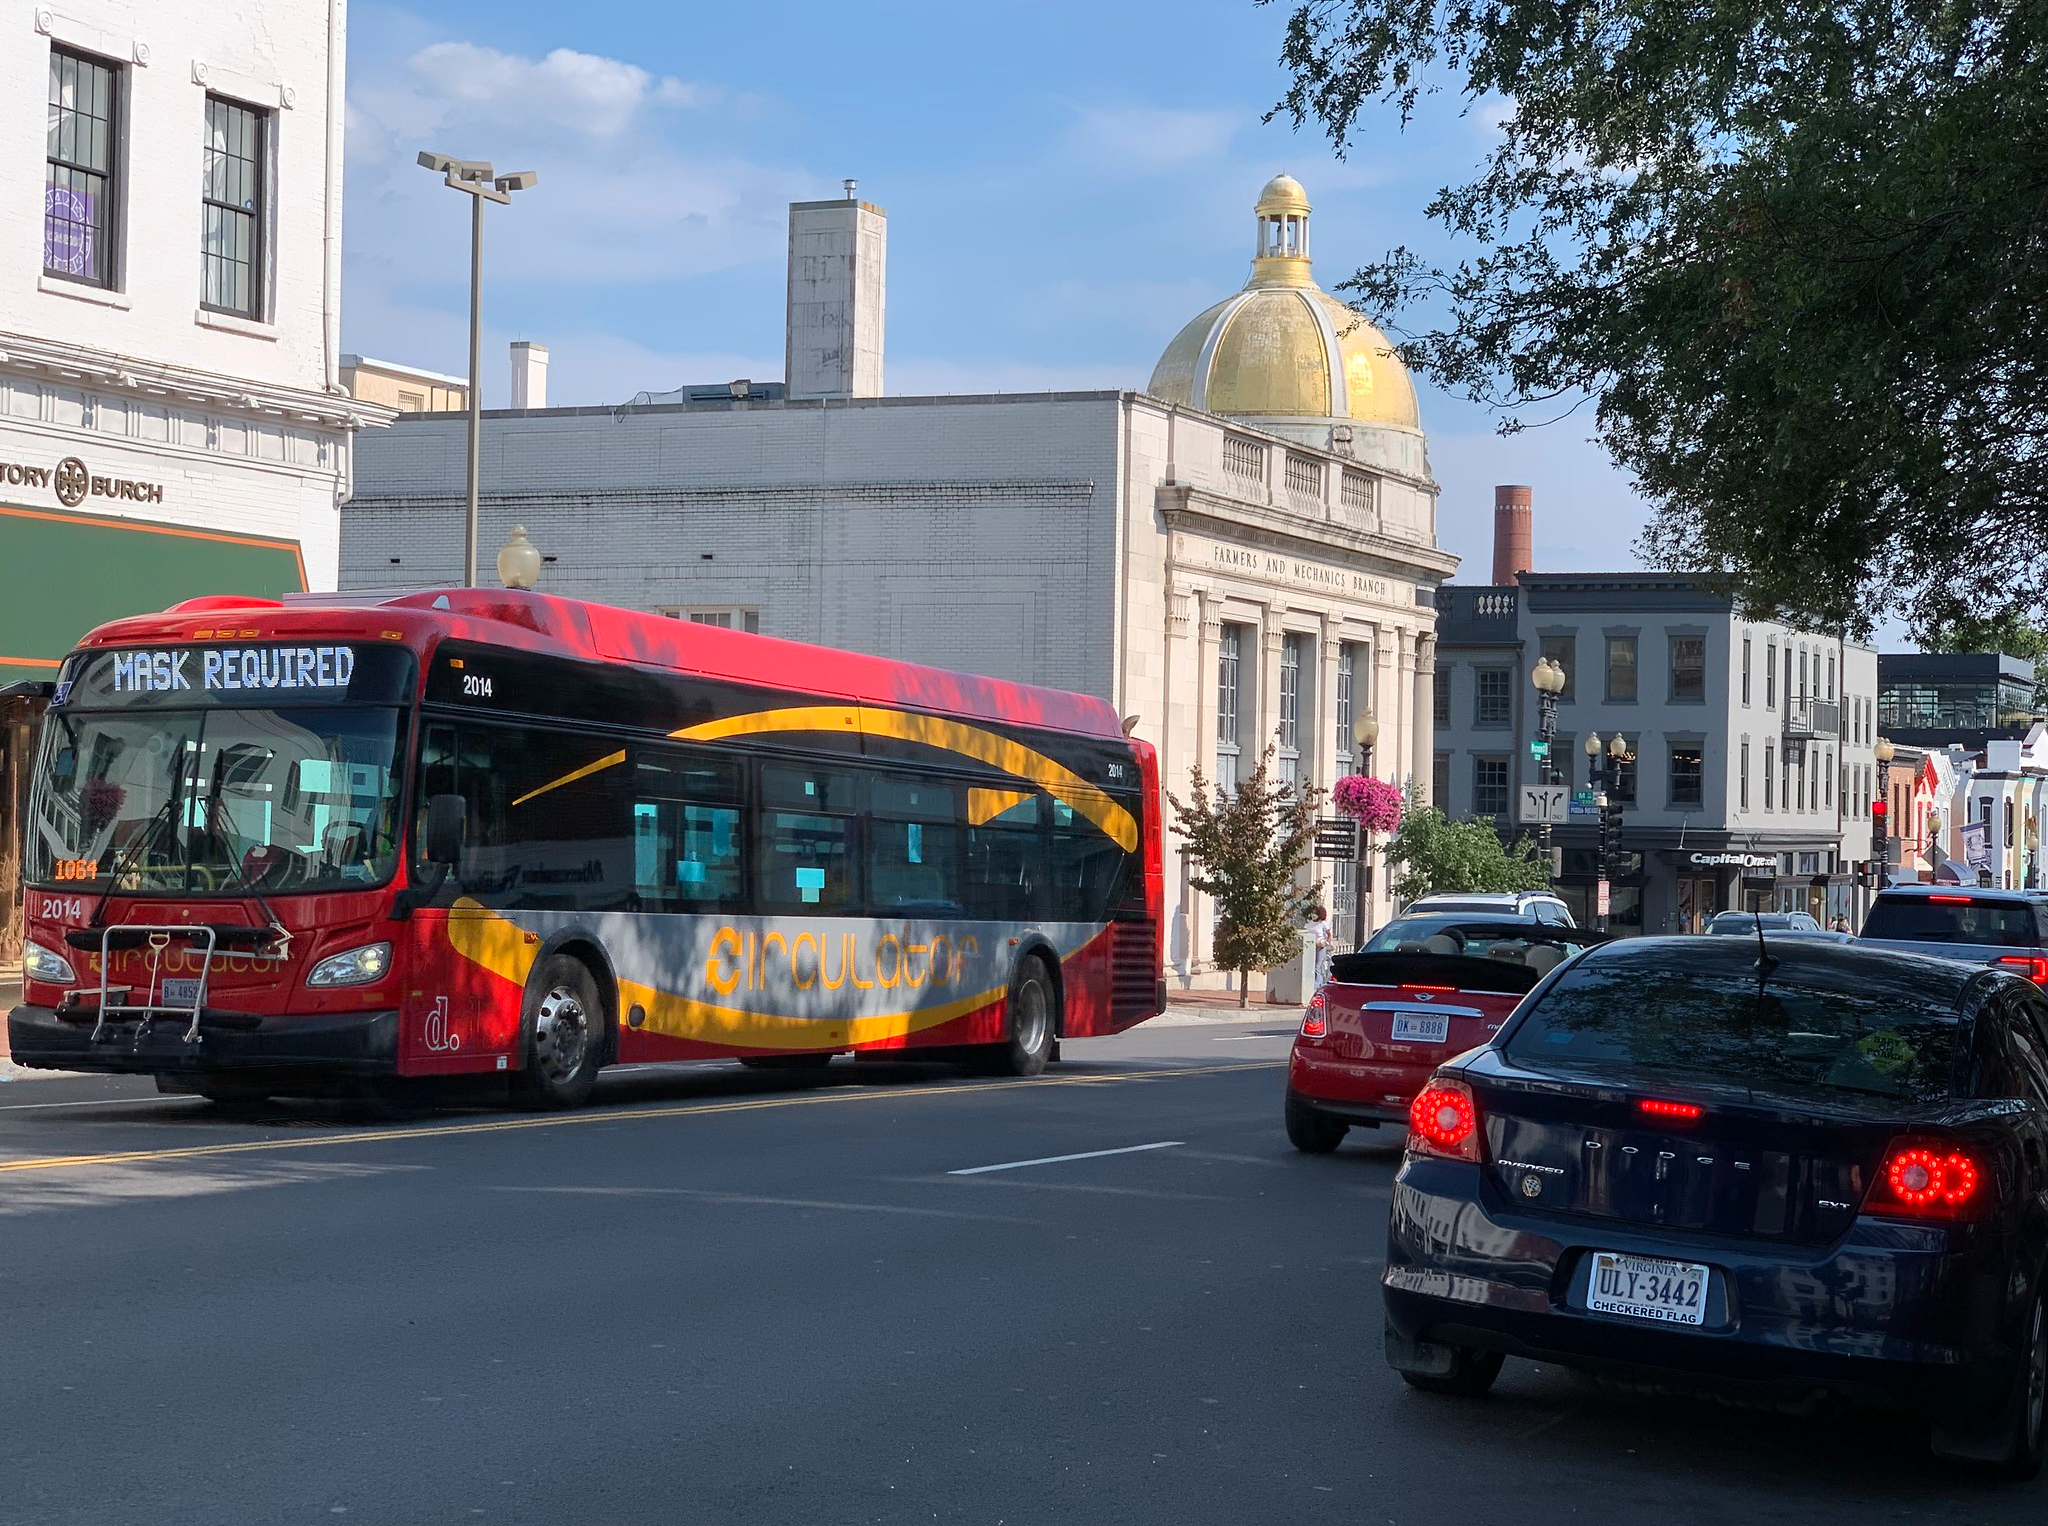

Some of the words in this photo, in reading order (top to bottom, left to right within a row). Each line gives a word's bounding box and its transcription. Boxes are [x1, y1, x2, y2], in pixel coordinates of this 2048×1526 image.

[0, 462, 53, 488] TORY
[91, 475, 163, 504] BURCH
[1214, 546, 1257, 569] FARMERS
[1266, 557, 1285, 574] AND
[1294, 563, 1345, 587] MECHANICS
[1353, 576, 1385, 596] BRANCH
[114, 651, 191, 691] MASK
[203, 646, 355, 690] REQUIRED
[463, 674, 493, 697] 2014
[1108, 763, 1123, 778] 2014
[55, 859, 98, 880] 1064
[42, 899, 81, 919] 2014
[178, 986, 201, 999] 4852
[1585, 1140, 1751, 1171] DODGE
[1818, 1200, 1851, 1209] SXT
[1622, 1259, 1678, 1277] VIRGINIA
[1626, 1254, 1654, 1263] VIRGINIA
[1600, 1268, 1700, 1308] ULY-3442
[1593, 1300, 1663, 1319] CHECKERED
[1666, 1311, 1697, 1323] FLAG
